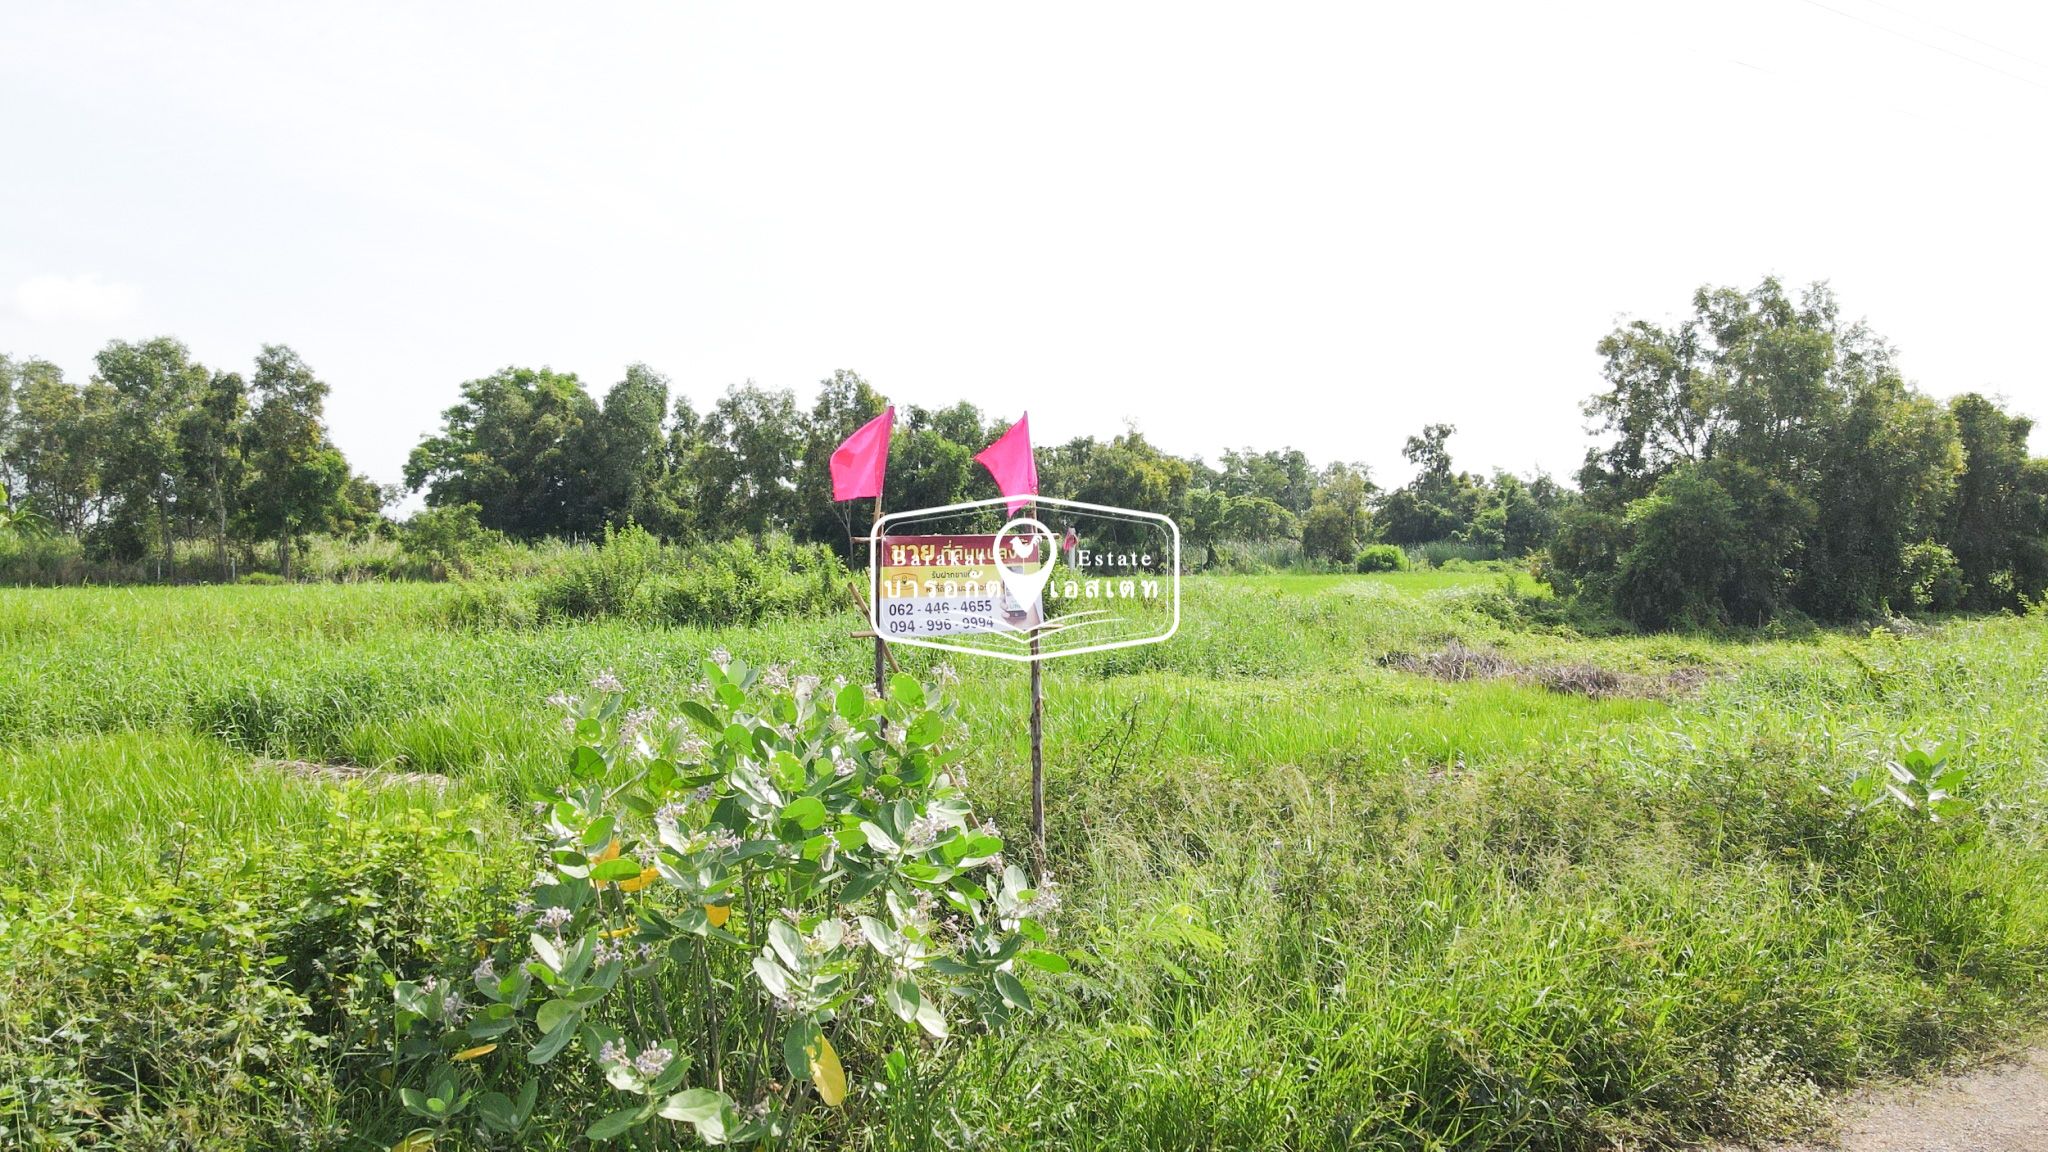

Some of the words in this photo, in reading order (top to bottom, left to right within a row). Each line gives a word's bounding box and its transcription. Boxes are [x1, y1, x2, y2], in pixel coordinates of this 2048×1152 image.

[889, 604, 914, 616] 062
[924, 602, 950, 614] 446
[960, 600, 992, 613] 4655
[889, 620, 915, 633] 094
[926, 618, 952, 631] 996
